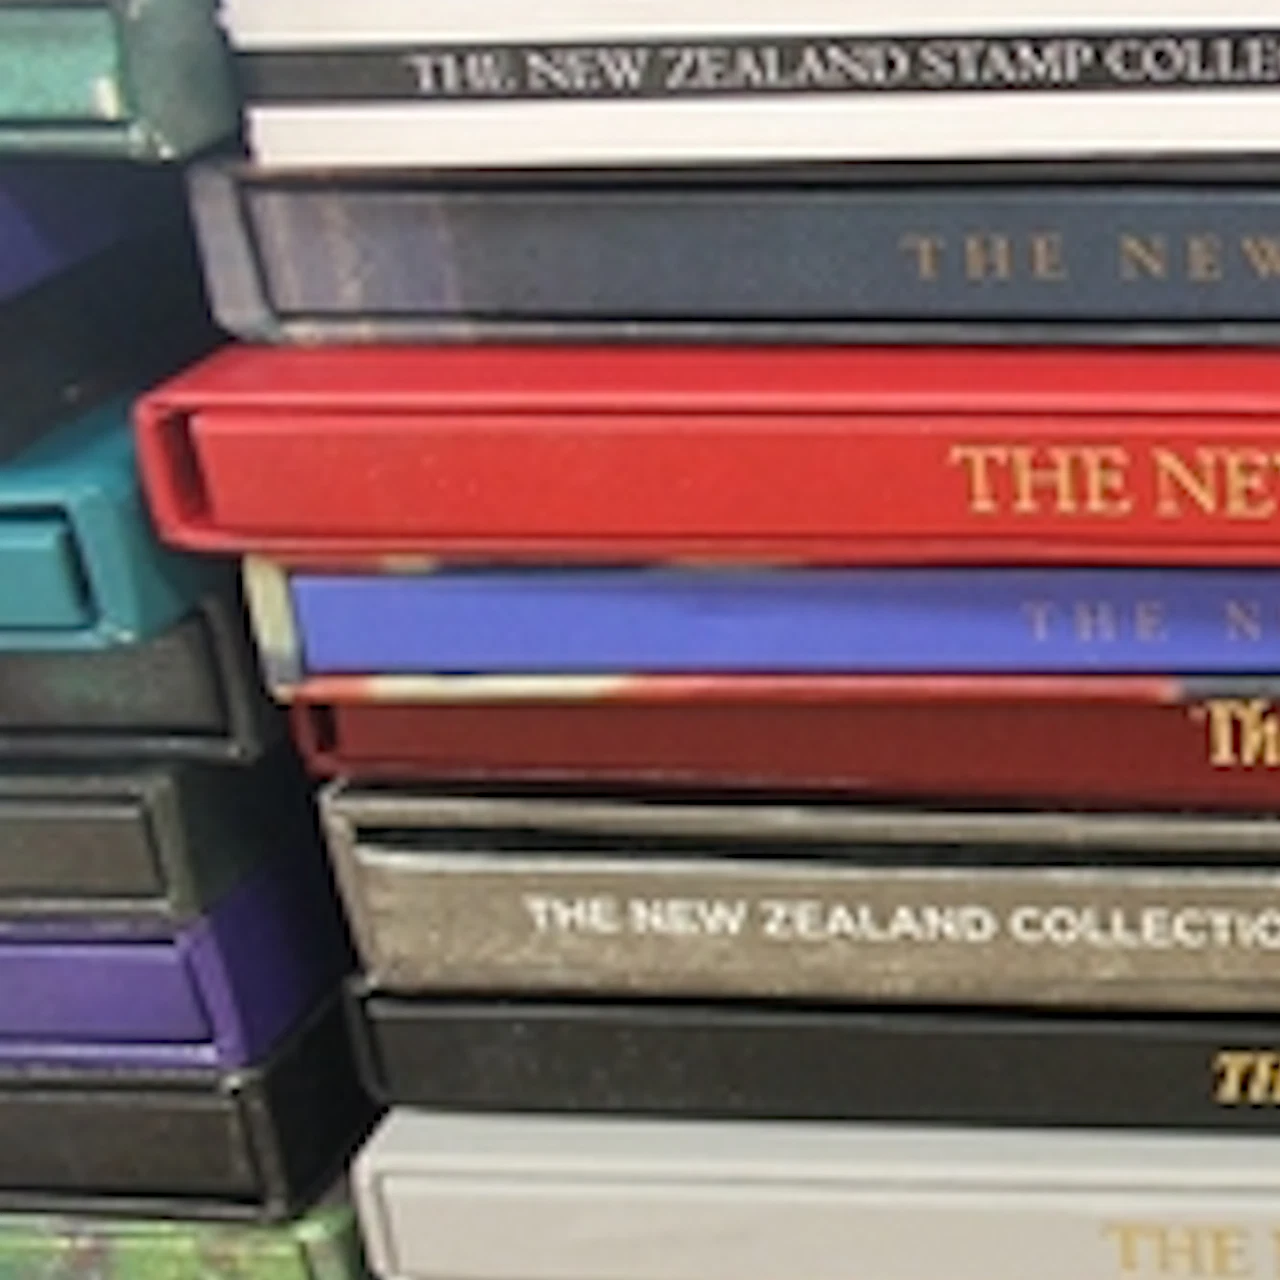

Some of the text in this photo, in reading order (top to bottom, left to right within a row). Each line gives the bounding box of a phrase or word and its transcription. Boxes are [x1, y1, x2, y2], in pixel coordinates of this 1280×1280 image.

[408, 51, 517, 91] THE
[526, 45, 650, 89] NEW
[661, 40, 908, 88] ZEALAND
[919, 37, 1092, 83] STAMP
[899, 233, 1068, 280] THE
[950, 445, 1131, 514] THE
[1022, 600, 1168, 643] THE
[523, 897, 614, 932] THE
[628, 899, 749, 936] NEW
[762, 901, 996, 944] ZEALAND
[1106, 1222, 1252, 1278] THE
